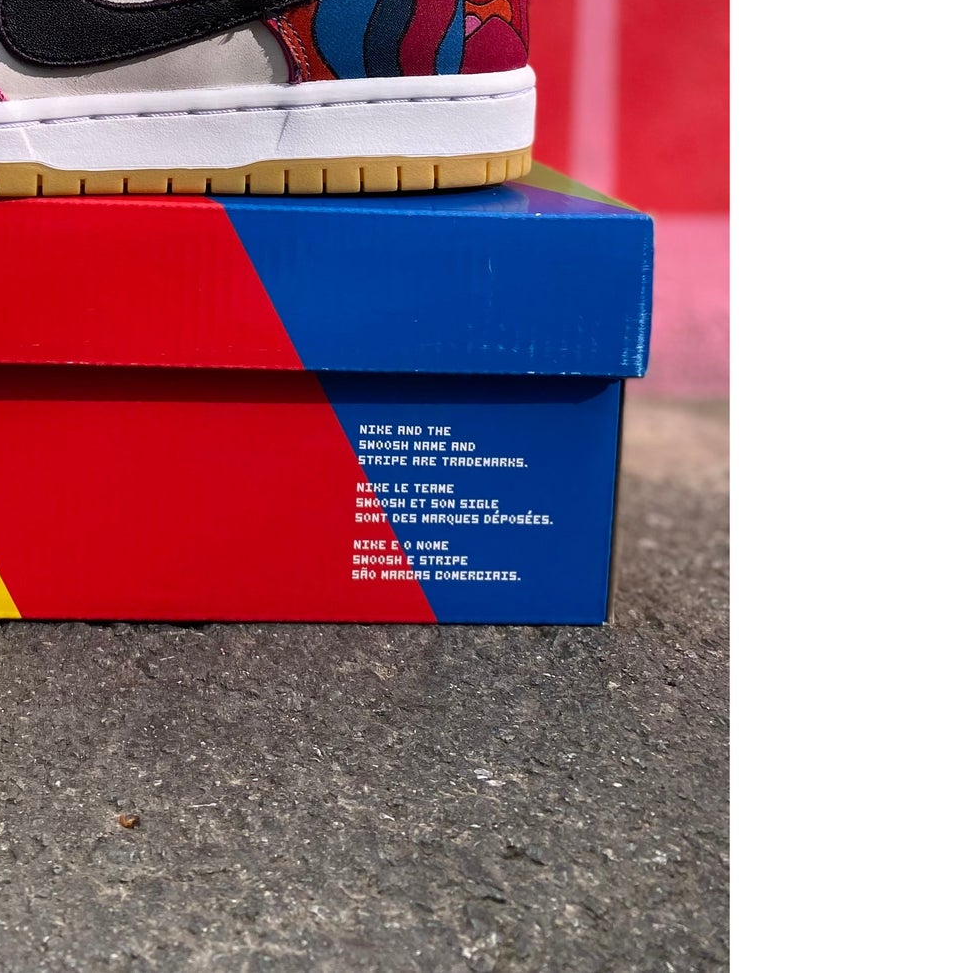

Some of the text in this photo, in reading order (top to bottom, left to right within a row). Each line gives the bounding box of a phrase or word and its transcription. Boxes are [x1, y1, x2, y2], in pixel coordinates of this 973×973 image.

[360, 425, 451, 436] NIKE AND THE
[359, 440, 475, 451] SWOOSH NAME AND
[358, 455, 528, 467] STRIPE ARE TRADEMARKS.
[357, 483, 389, 492] NIKE
[395, 483, 408, 493] LE
[356, 498, 499, 509] SWOOSH ET SON SIGLE
[355, 510, 554, 525] SONT DES MARQUES DÉPOSÉES.
[354, 540, 449, 550] NIKE E O NOME
[353, 555, 468, 565] SWOOSH E STRIPE
[352, 567, 521, 580] SÃO MARCAS COMERCIAIS.
